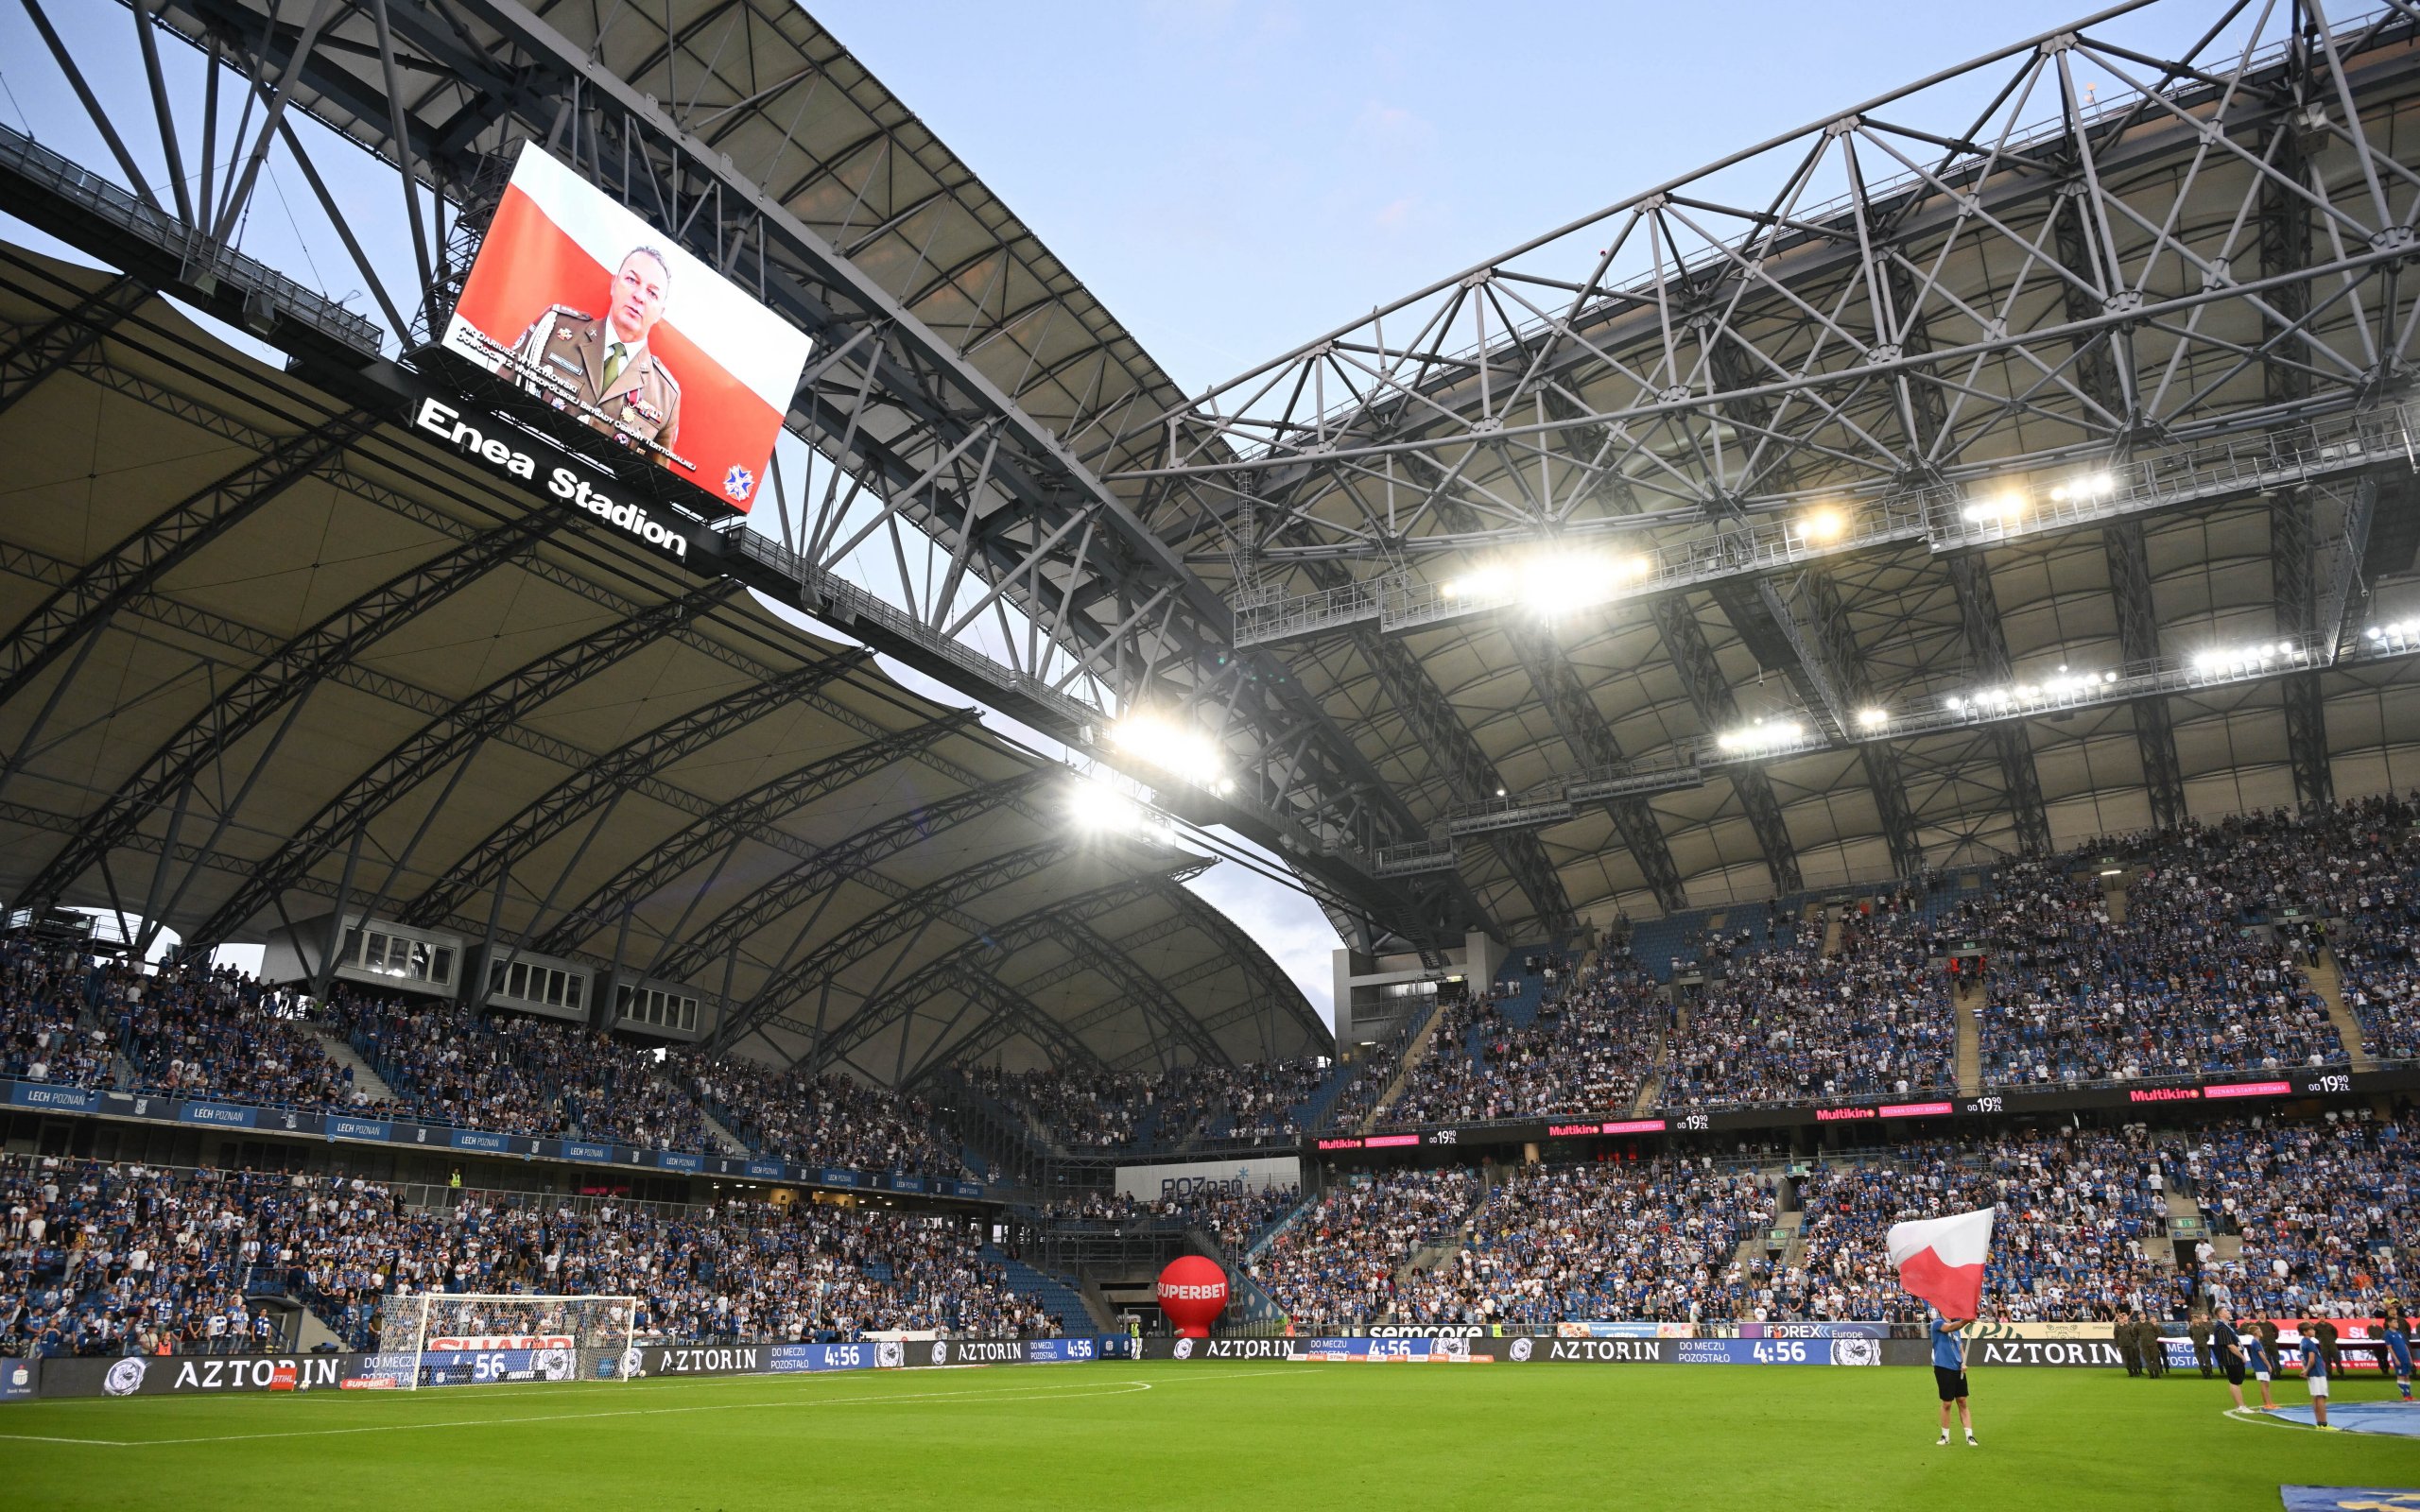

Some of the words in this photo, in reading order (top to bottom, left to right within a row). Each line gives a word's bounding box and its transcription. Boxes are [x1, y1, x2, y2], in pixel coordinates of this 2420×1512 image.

[478, 330, 516, 358] DARIUSZ
[417, 397, 535, 480] Enea
[547, 467, 687, 557] Stadion
[28, 1091, 50, 1103] LECH
[52, 1092, 85, 1106] POZNAŃ
[2130, 1089, 2199, 1102] Multikino
[194, 1108, 213, 1119] LECH
[215, 1109, 243, 1122] POZNAŃ
[1816, 1108, 1875, 1121] Multikino
[337, 1123, 354, 1133] LECH
[355, 1125, 380, 1135] POZNAŃ
[1548, 1125, 1599, 1136] Multikino
[461, 1136, 476, 1144] LECH
[1319, 1140, 1361, 1149] Multikino
[570, 1147, 583, 1156] LECH
[666, 1157, 678, 1165] LECH
[1157, 1282, 1225, 1299] SUPERBET
[1370, 1326, 1482, 1337] semcore
[1832, 1330, 1864, 1339] Europe
[771, 1348, 782, 1357] DO
[783, 1347, 805, 1357] MECZU
[958, 1343, 1021, 1361] AZTORIN
[1067, 1340, 1092, 1357] 4:56
[1207, 1340, 1295, 1357] AZTORIN
[1369, 1340, 1410, 1355] 4:56
[1551, 1341, 1660, 1360] AZTORIN
[1679, 1342, 1692, 1350] DO
[1694, 1342, 1725, 1350] MECZU
[1754, 1341, 1806, 1362] 4:56
[824, 1346, 859, 1366] 4:56
[1984, 1343, 2123, 1364] AZTORIN
[364, 1357, 378, 1368] DO
[661, 1349, 756, 1372] AZTORIN
[272, 1375, 293, 1383] STIHL
[346, 1379, 389, 1387] SUPERBET
